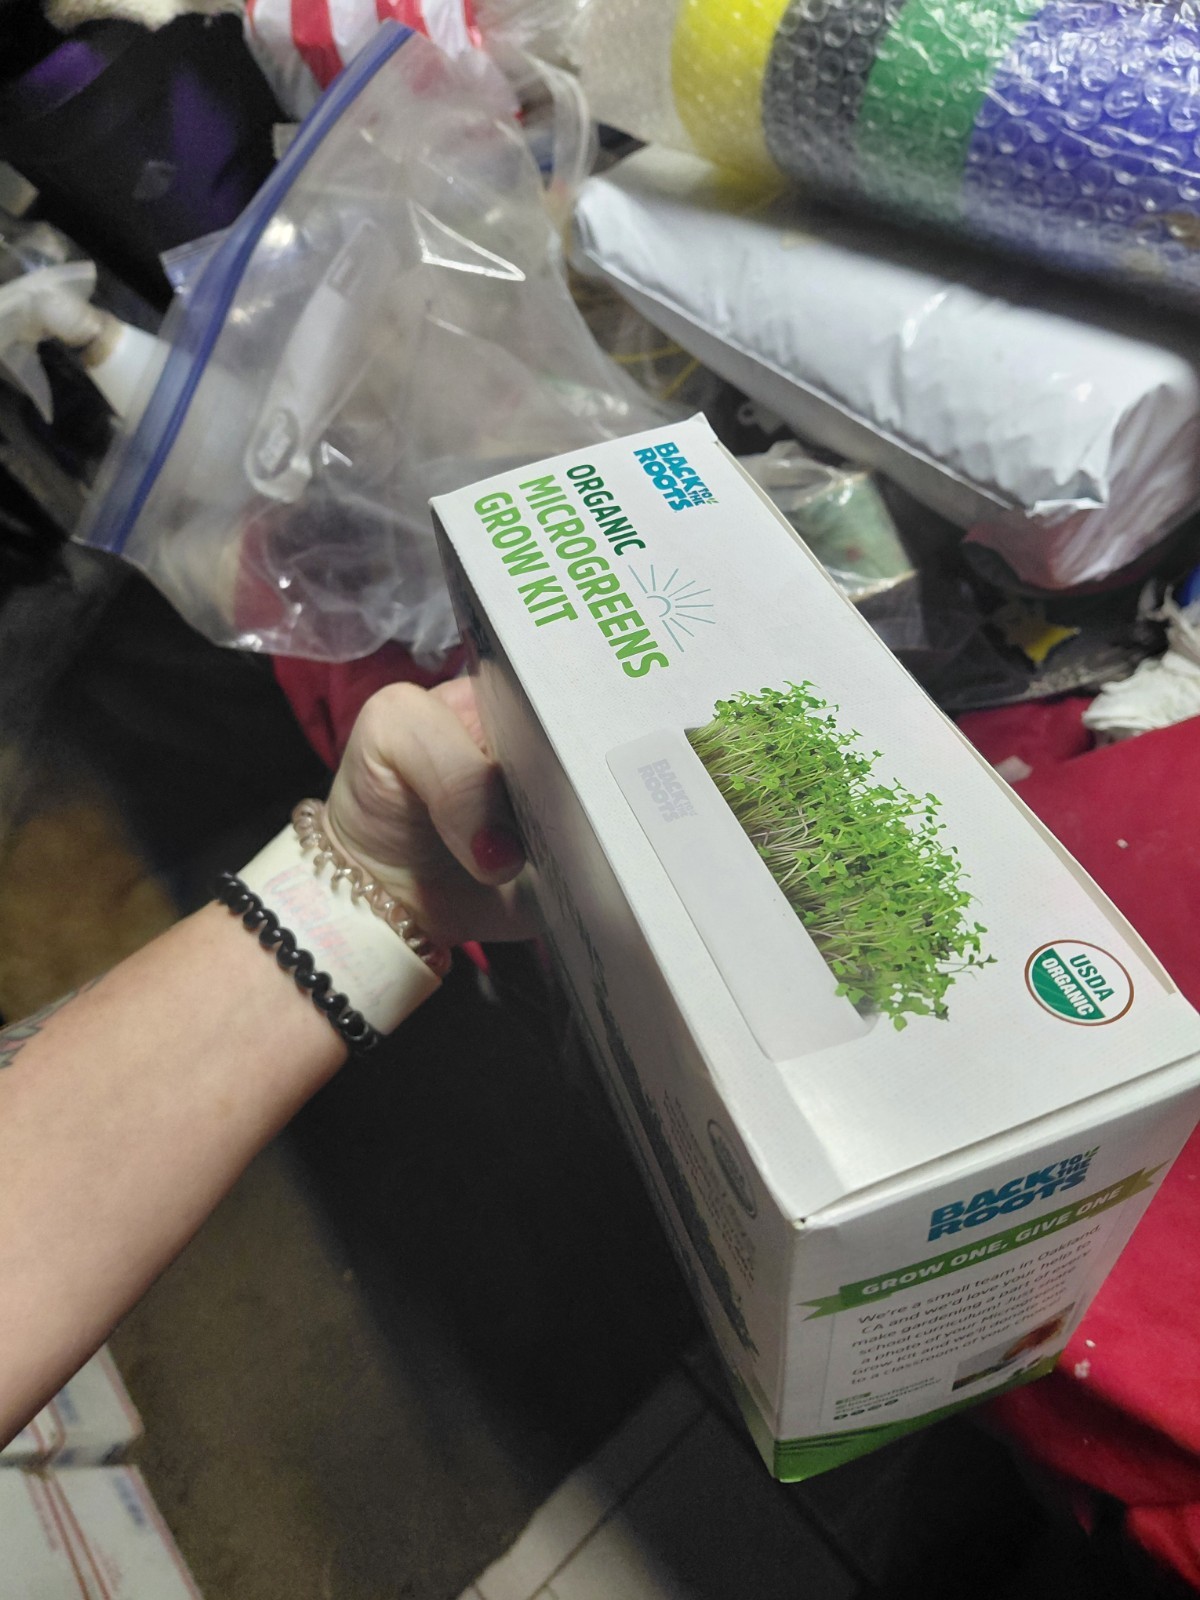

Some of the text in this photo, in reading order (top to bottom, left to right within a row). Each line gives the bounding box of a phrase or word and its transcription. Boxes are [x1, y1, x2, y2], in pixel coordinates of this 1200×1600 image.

[633, 447, 694, 511] ROOTS
[654, 442, 713, 506] BACK TO THE
[566, 464, 646, 557] ORGANIC
[474, 492, 579, 628] GROW KIT
[518, 474, 670, 678] MICROGREENS
[637, 764, 680, 823] ROOTS
[652, 758, 689, 806] BACK
[1041, 957, 1094, 1016] ORGANIC
[1069, 953, 1115, 1002] USDA
[927, 1167, 1088, 1242] ROOTS
[930, 1153, 1091, 1227] BACK TO THE
[861, 1185, 1122, 1295] GROW ONE, GIVE ONE
[852, 1331, 897, 1347] make
[901, 1302, 982, 1334] gardening
[999, 1281, 1030, 1299] part
[1034, 1271, 1050, 1282] of
[858, 1306, 907, 1324] We're
[927, 1284, 970, 1303] small
[975, 1268, 1015, 1287] team
[1019, 1260, 1034, 1269] in
[862, 1240, 1091, 1334] CA and we'd love your help to
[859, 1335, 911, 1355] school
[875, 1342, 921, 1361] photo
[925, 1334, 941, 1344] of
[944, 1322, 978, 1338] your
